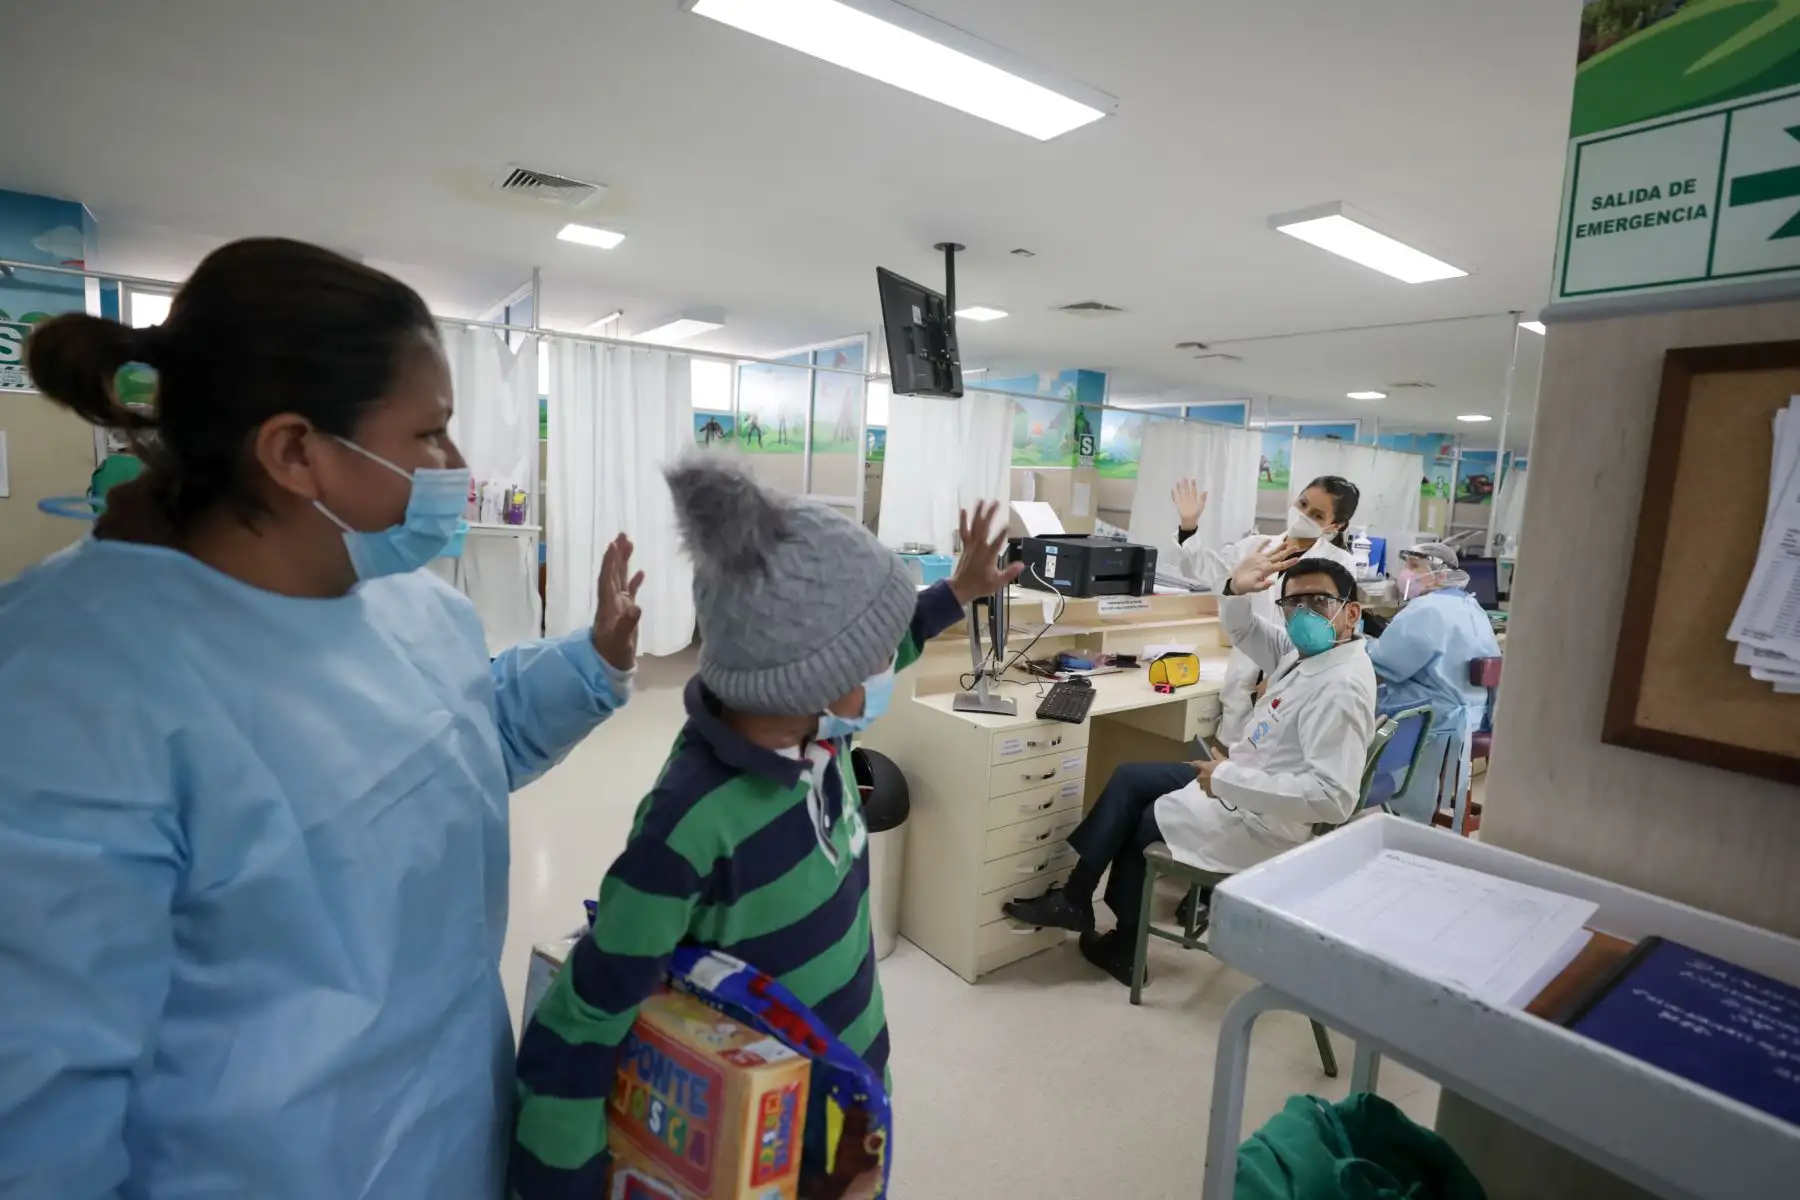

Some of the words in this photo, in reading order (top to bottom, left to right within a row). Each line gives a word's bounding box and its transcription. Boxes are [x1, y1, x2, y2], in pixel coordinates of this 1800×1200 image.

[1591, 185, 1662, 211] SALIDA
[1669, 178, 1698, 197] DE
[1575, 204, 1708, 239] EMERGENCIA
[1081, 436, 1093, 455] S
